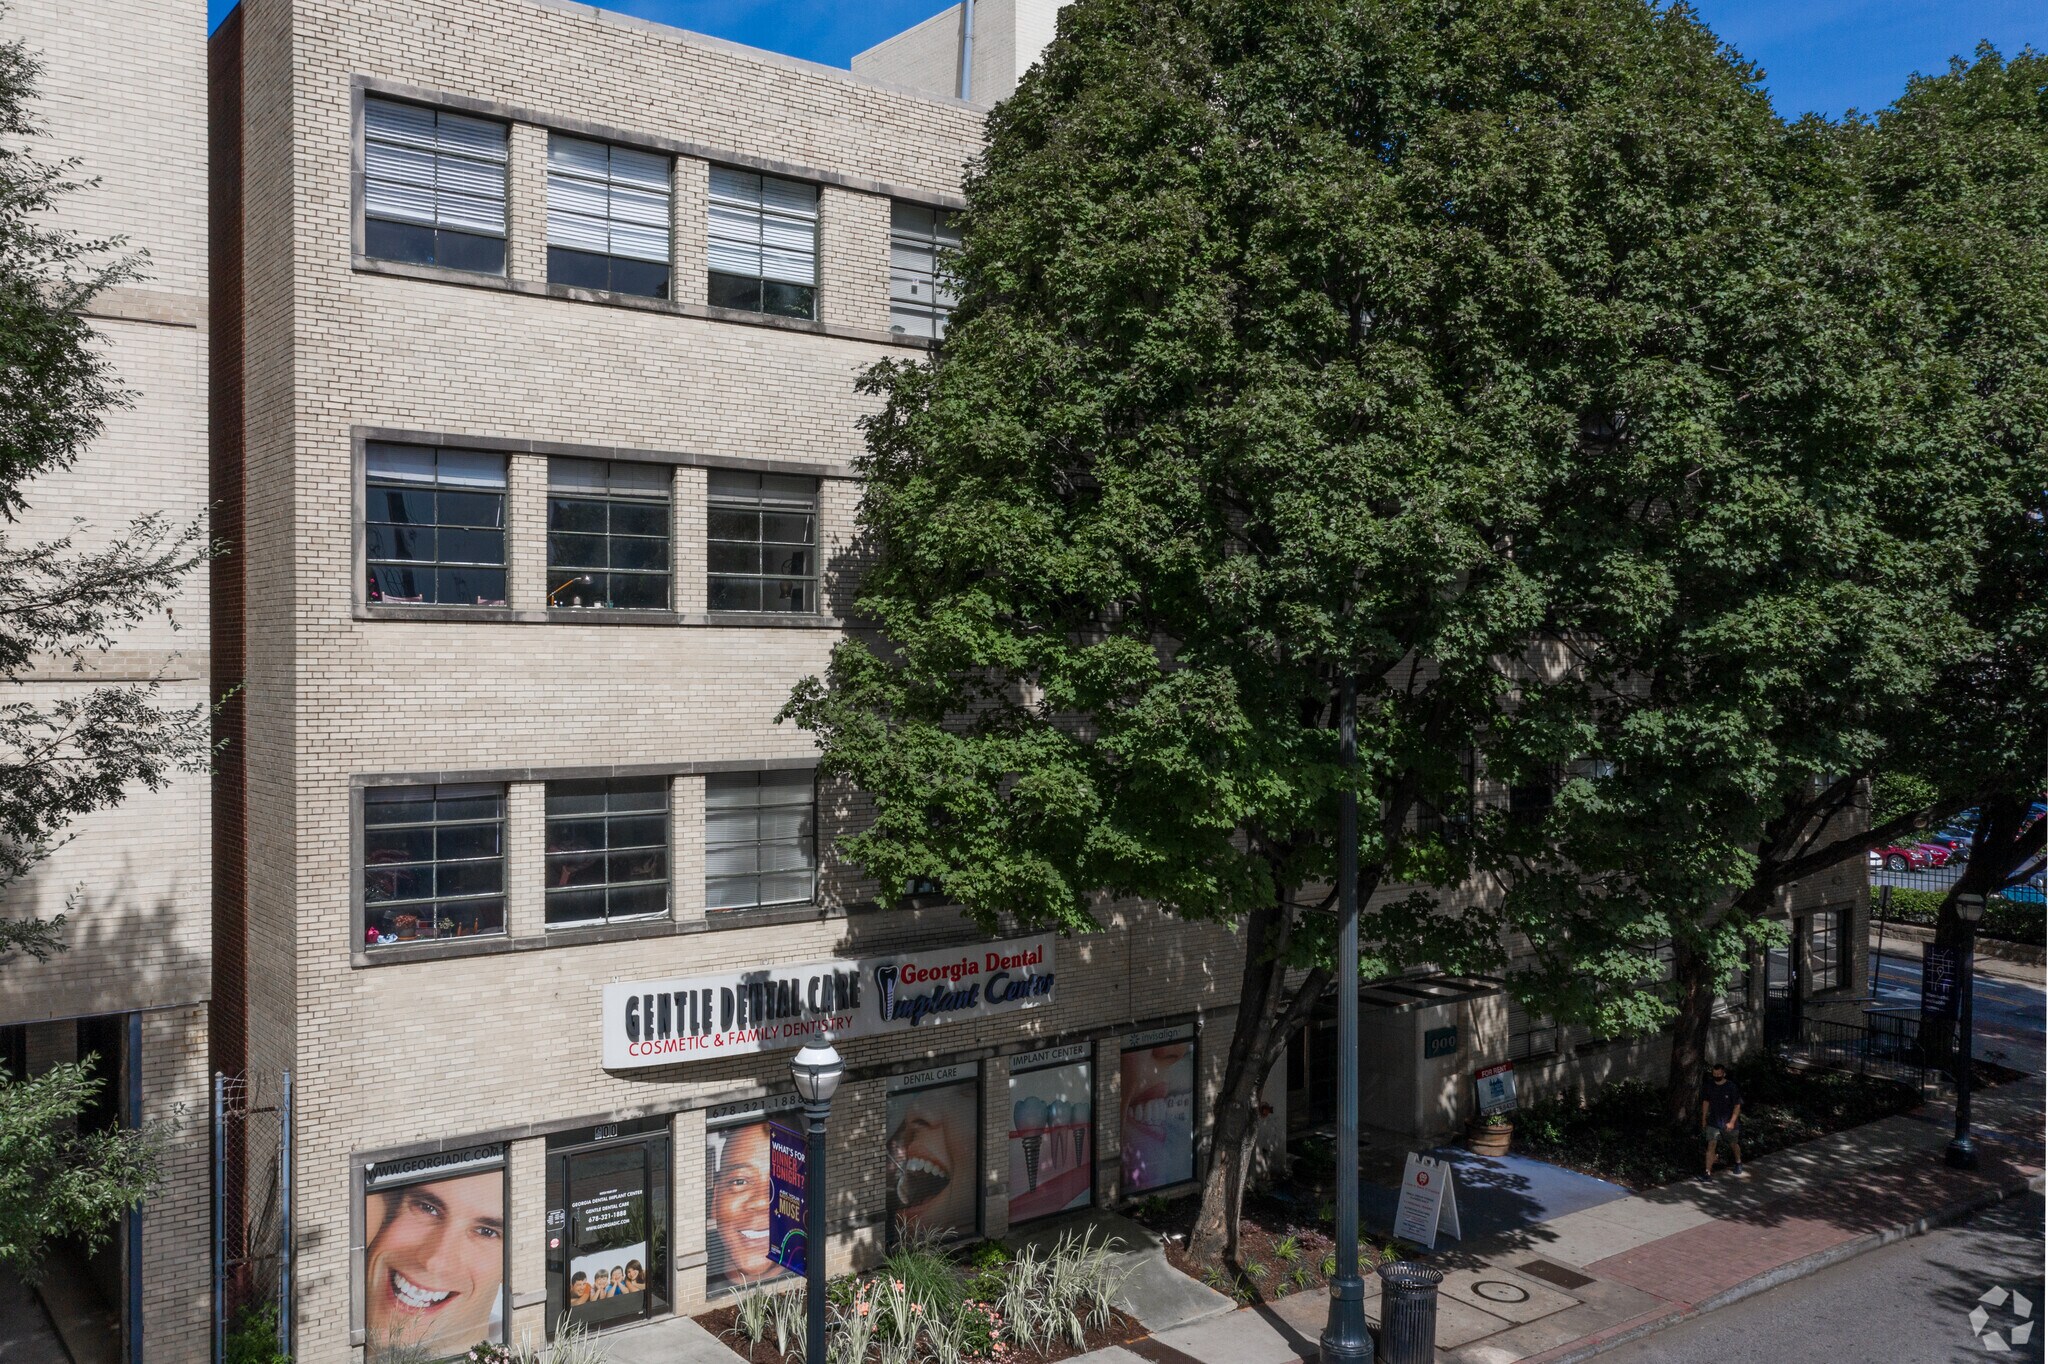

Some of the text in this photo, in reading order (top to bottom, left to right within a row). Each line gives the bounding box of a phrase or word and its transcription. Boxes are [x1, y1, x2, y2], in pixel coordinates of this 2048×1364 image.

[901, 944, 1043, 985] Georgia Dental
[984, 972, 1055, 1004] Center
[625, 970, 861, 1042] GENTLE DENTAL CARE
[629, 1015, 853, 1057] COSMETIC & FAMILY DENTISTRY
[1142, 1029, 1178, 1042] invisalign
[1432, 1036, 1456, 1055] 900
[1013, 1045, 1083, 1067] IMPLANT CENTER
[904, 1068, 957, 1085] DENTAL CARE
[1482, 1069, 1493, 1077] FOR
[367, 1145, 499, 1180] WWW.GEORGIADIC.COM
[772, 1141, 806, 1162] WHAT'S FOR
[772, 1150, 798, 1172] DINNER
[772, 1163, 805, 1189] TONIGHT?
[572, 1199, 591, 1208] GEORGIA
[779, 1198, 800, 1222] MUSE
[588, 1210, 627, 1223] 678-321-1888
